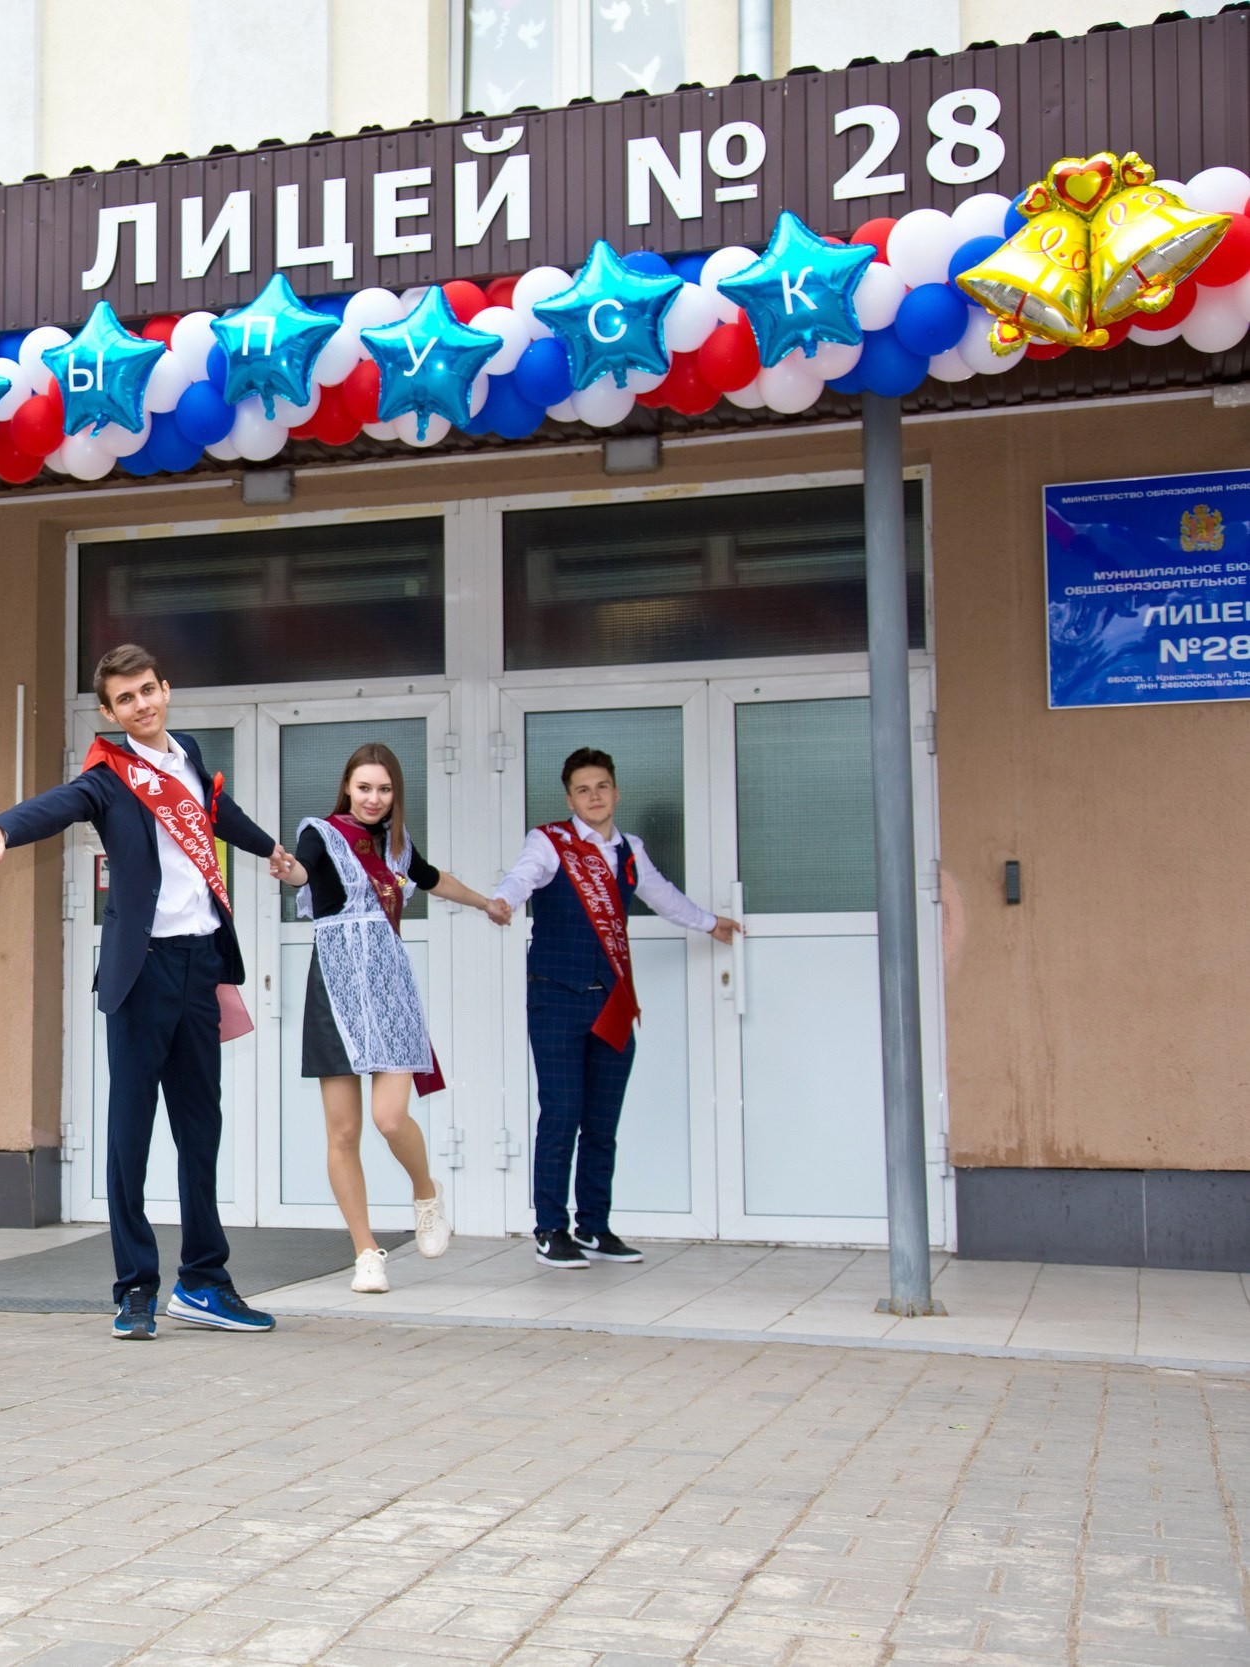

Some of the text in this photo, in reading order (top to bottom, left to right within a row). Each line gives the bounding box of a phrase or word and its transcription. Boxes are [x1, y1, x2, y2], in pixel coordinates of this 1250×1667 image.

[81, 124, 532, 291] ЛИЦЕЙ
[626, 119, 768, 227] №
[831, 86, 1007, 202] 28
[1062, 491, 1144, 504] МИНИСТЕРСТВО
[1146, 485, 1223, 498] ОБРАЗОВАНИЯ
[1093, 562, 1250, 581] МУНИЦИПАЛЬНОЕ БЮ
[1160, 635, 1250, 663] №28
[156, 805, 185, 841] Лицей
[176, 799, 216, 867] Выпуск
[582, 854, 616, 917] Выпуск
